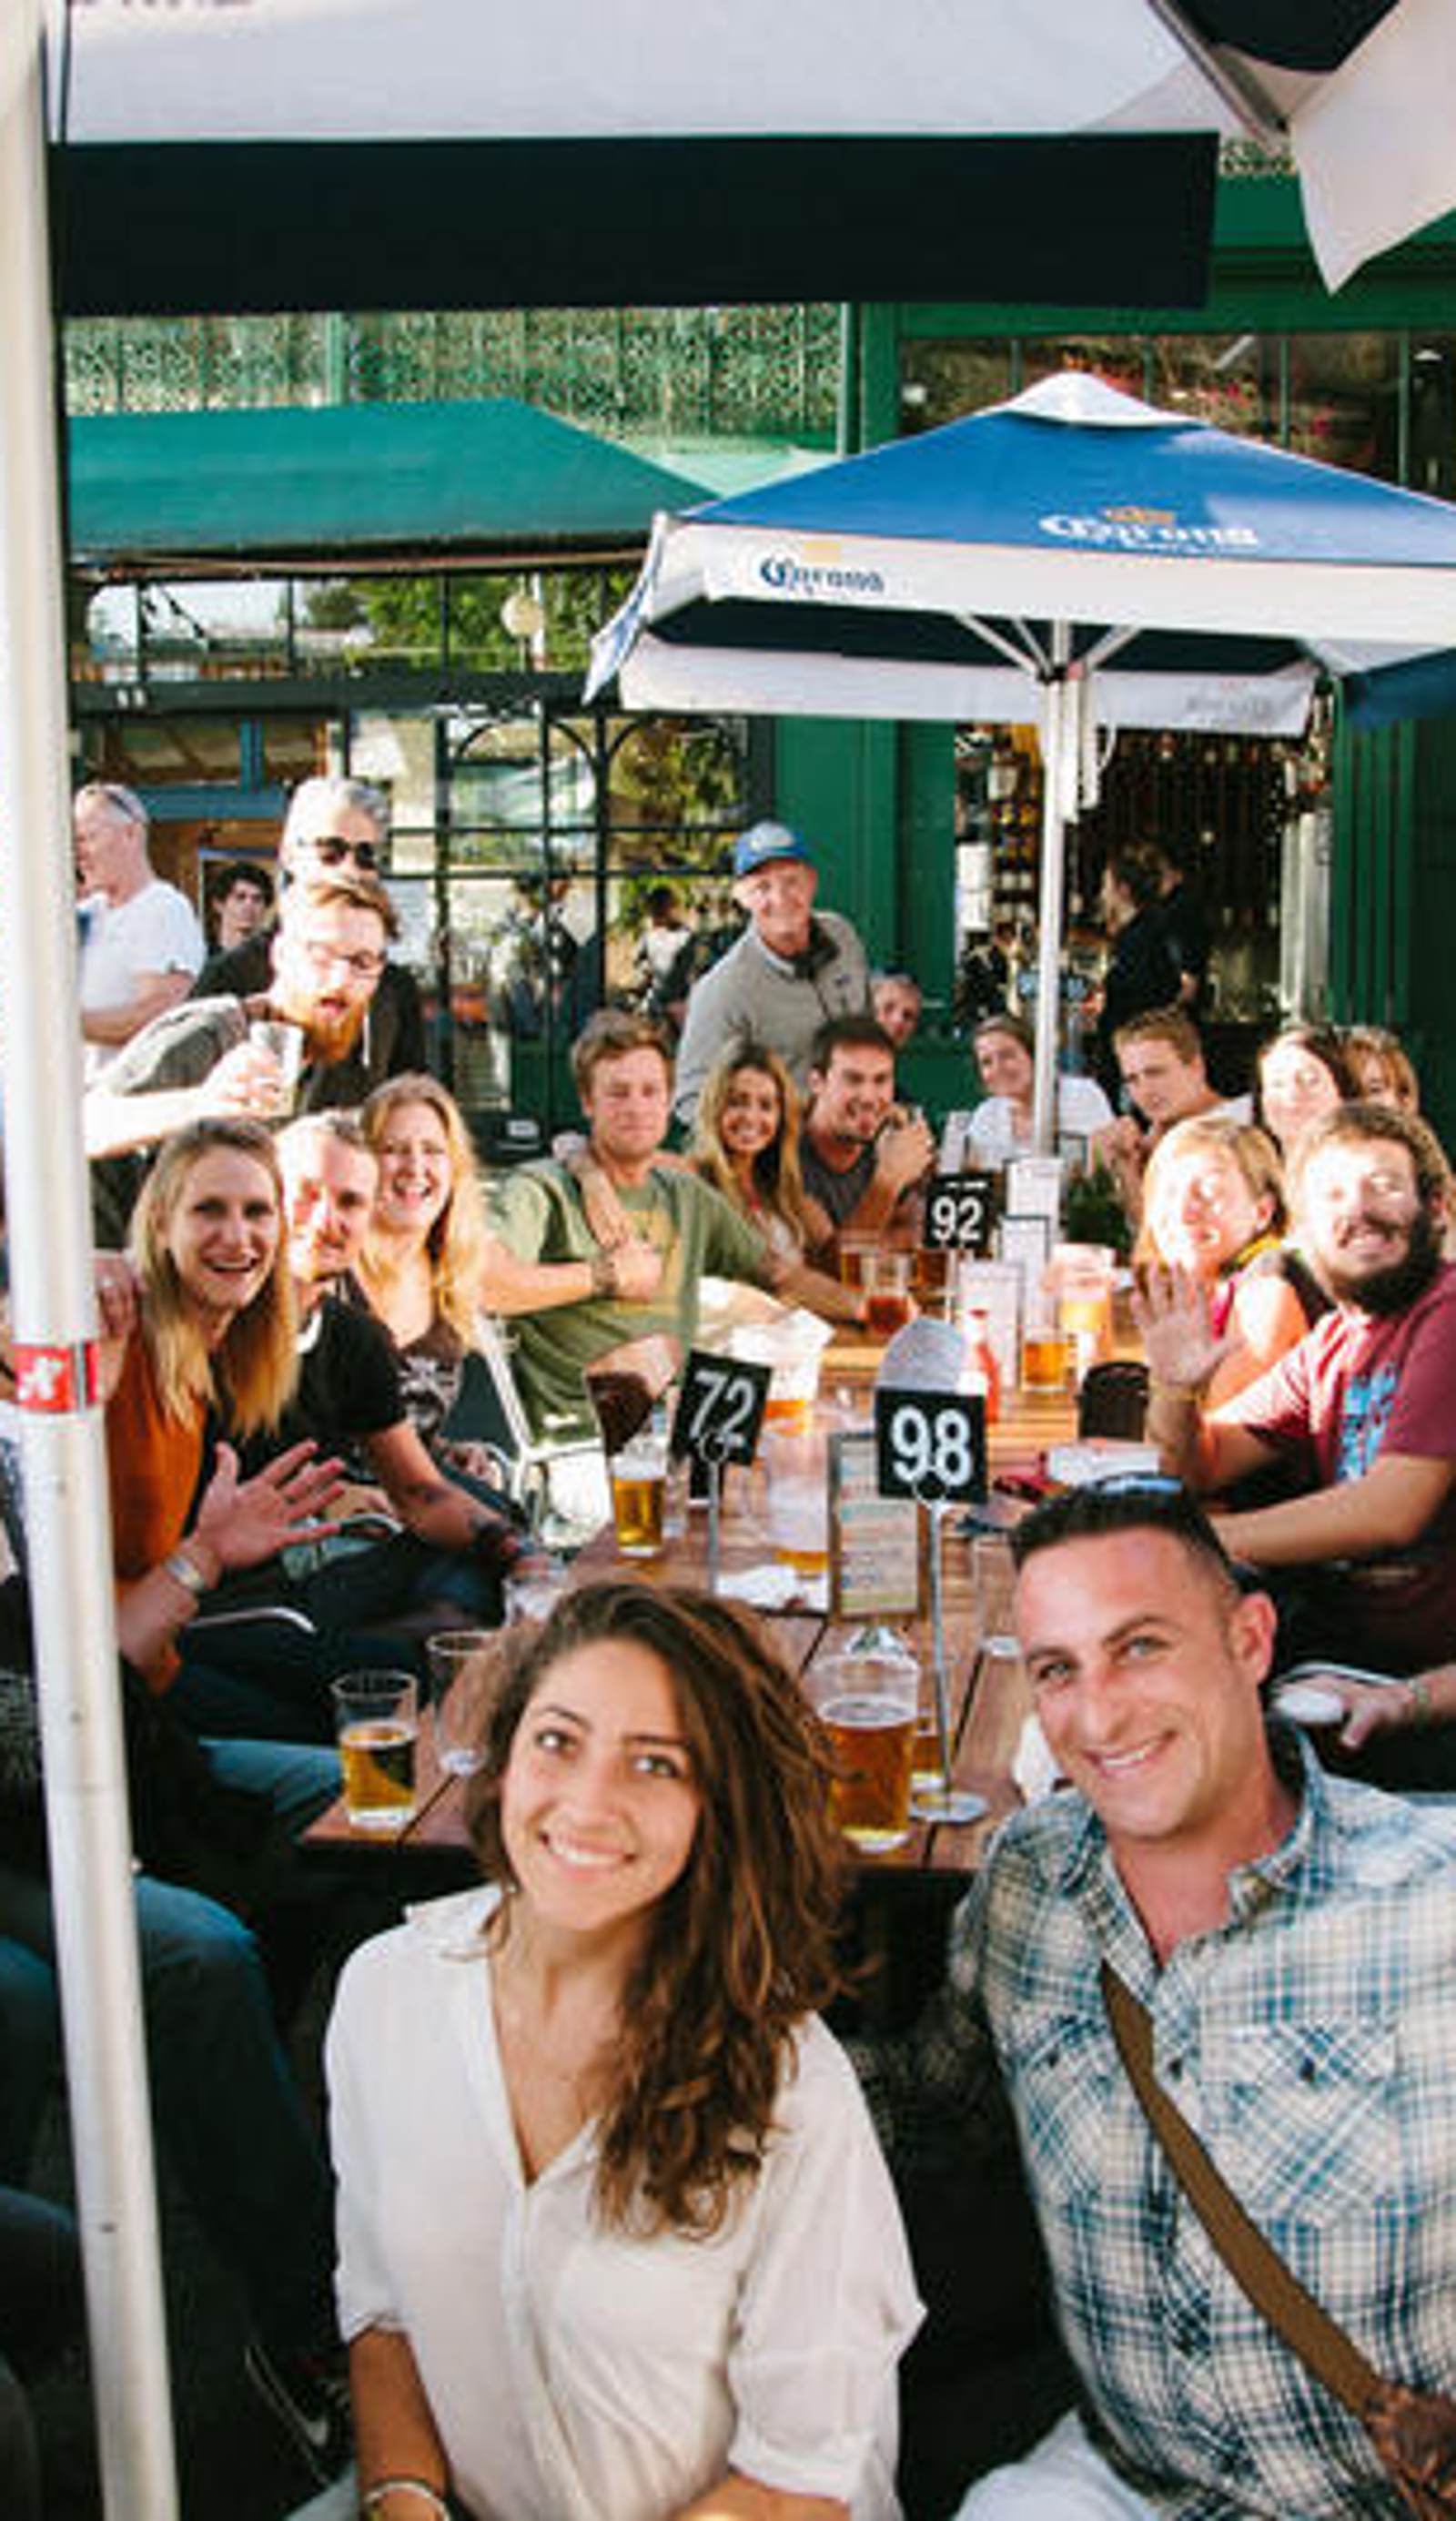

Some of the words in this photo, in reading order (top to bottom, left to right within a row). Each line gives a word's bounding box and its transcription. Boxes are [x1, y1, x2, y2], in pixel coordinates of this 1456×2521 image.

[760, 556, 885, 595] Corona
[932, 1196, 983, 1240] 92
[689, 1370, 754, 1447] 72
[891, 1405, 971, 1485] 98
